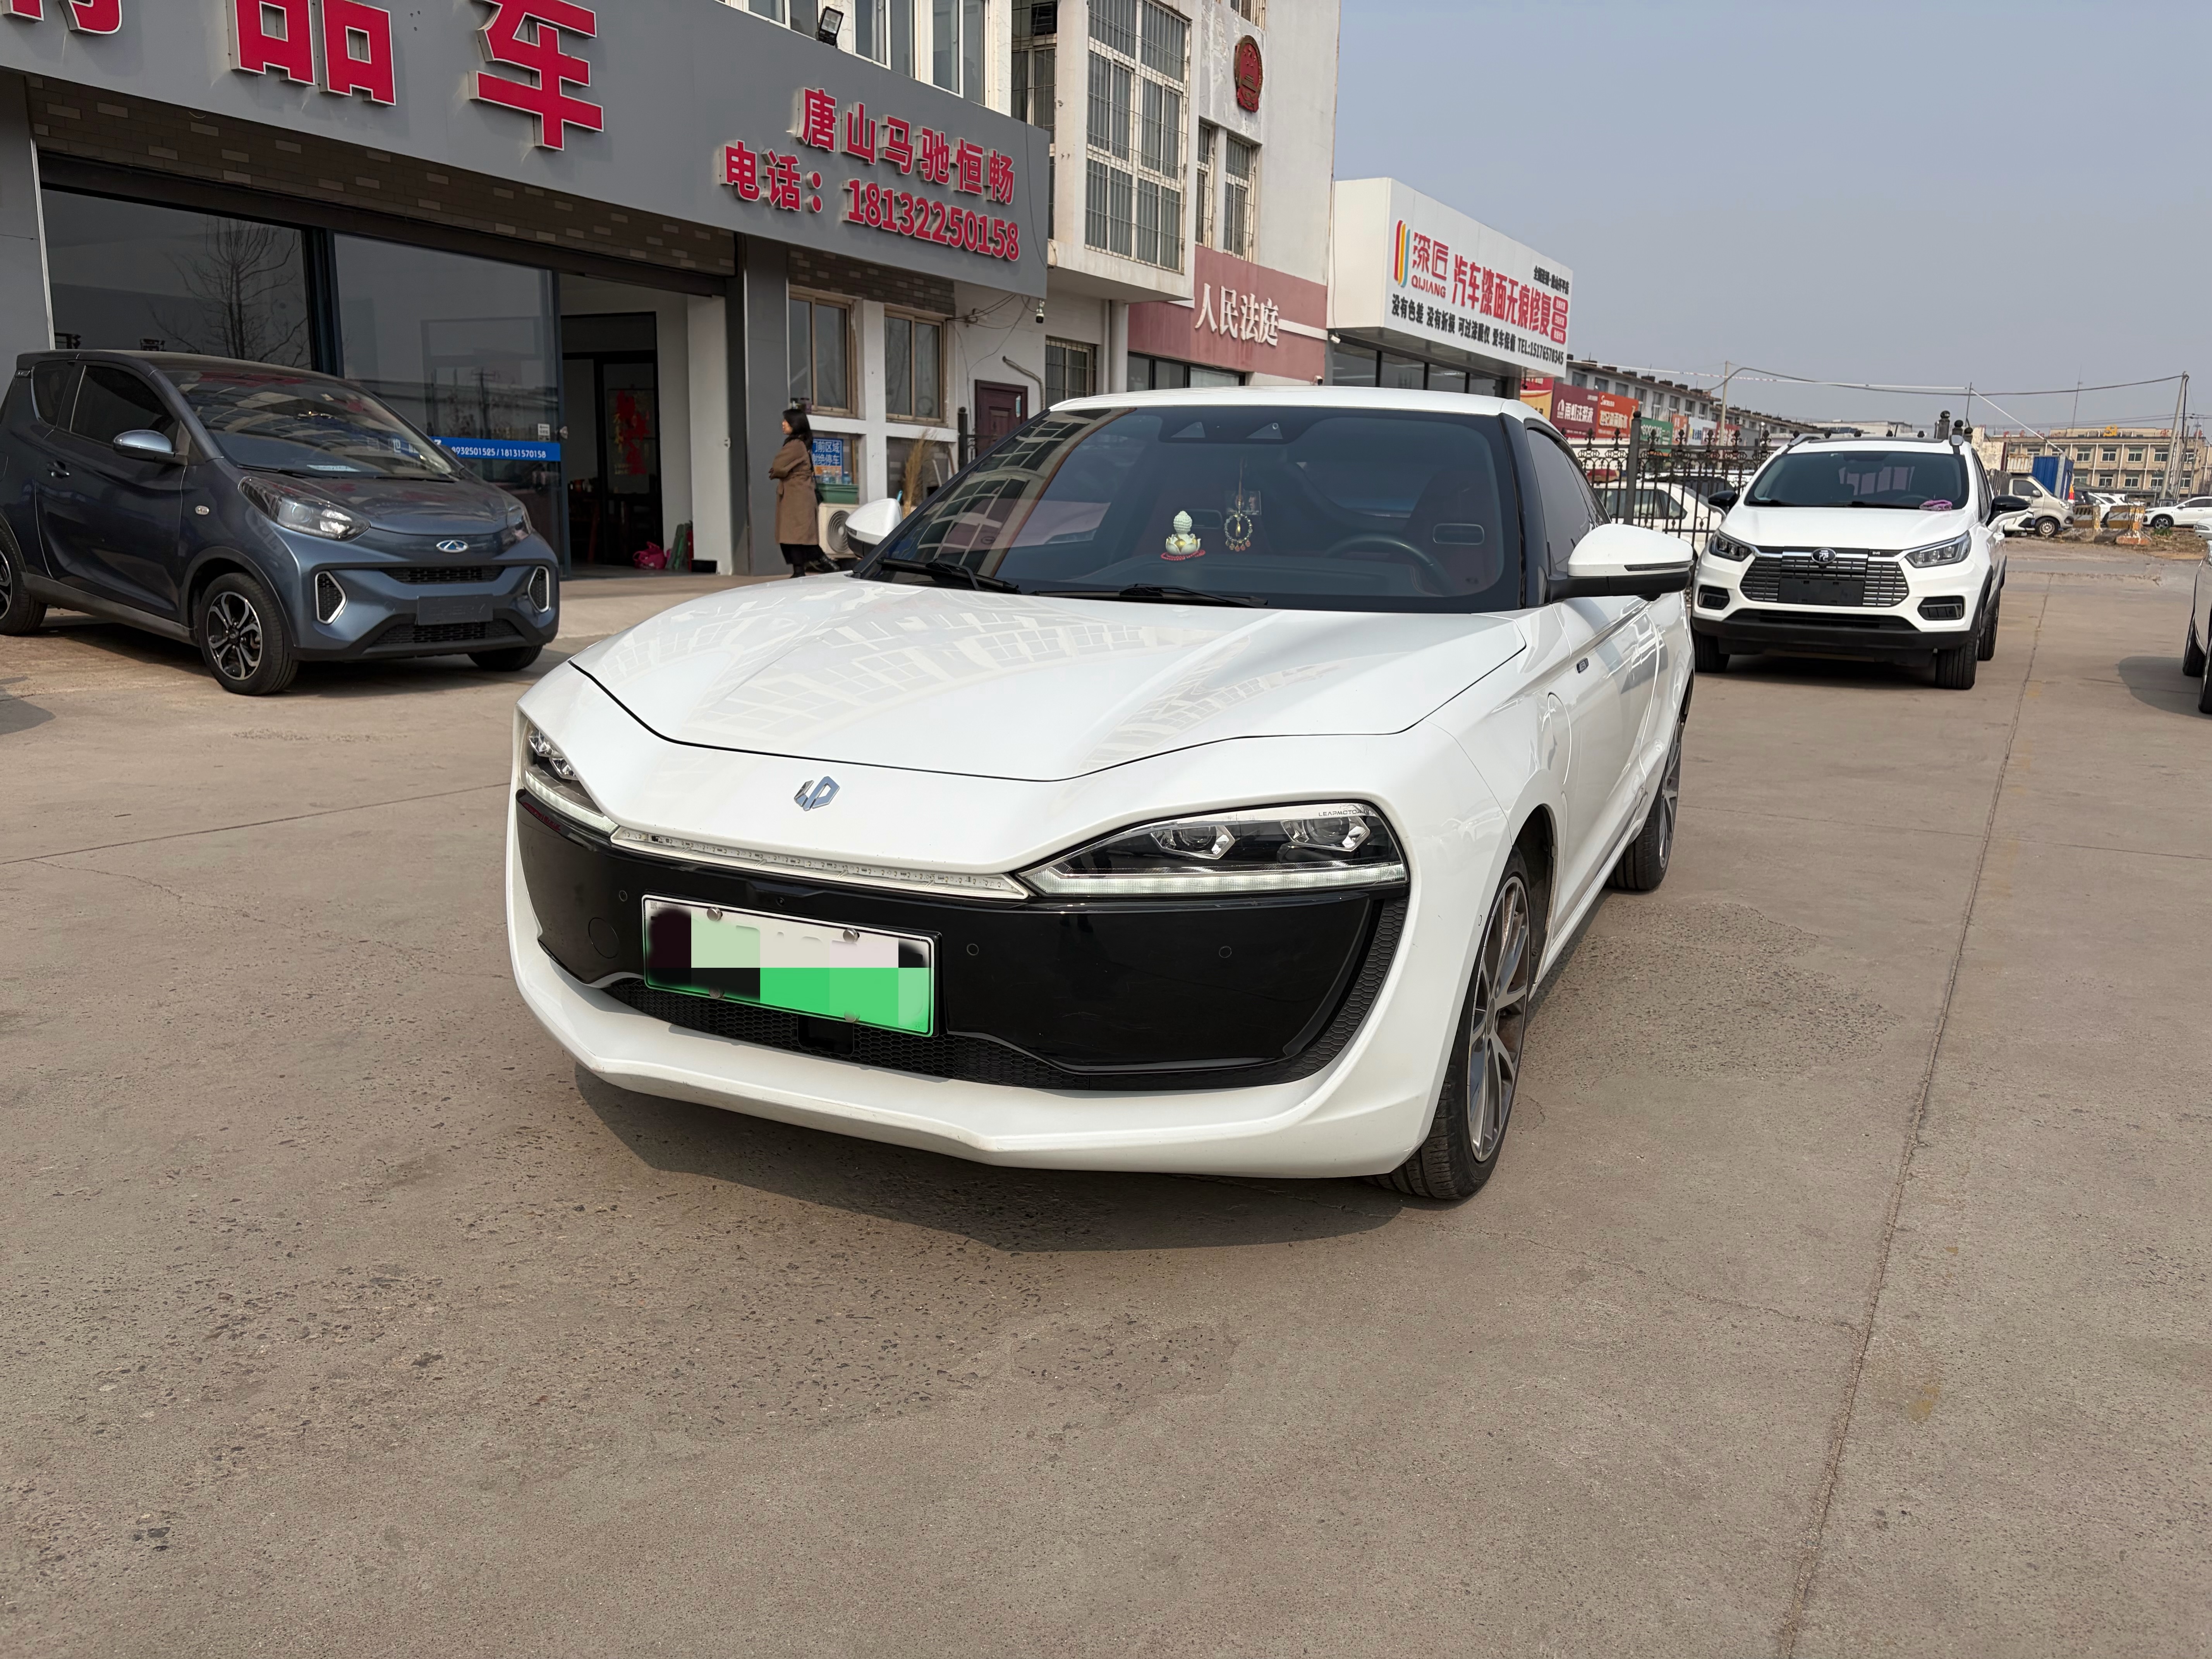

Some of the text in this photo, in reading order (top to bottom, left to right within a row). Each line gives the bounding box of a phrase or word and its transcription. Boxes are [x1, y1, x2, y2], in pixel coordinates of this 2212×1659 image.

[0, 0, 604, 151] 品车
[796, 88, 1015, 205] 唐山马驰恒畅
[843, 178, 1021, 262] 18132250158
[1195, 283, 1279, 346] 人民法庭
[1411, 275, 1446, 299] QIJIANG
[1452, 254, 1551, 336] 汽车漆面无痕修复
[1392, 293, 1424, 324] 没有色差
[1518, 337, 1564, 365] TEL:15176570345
